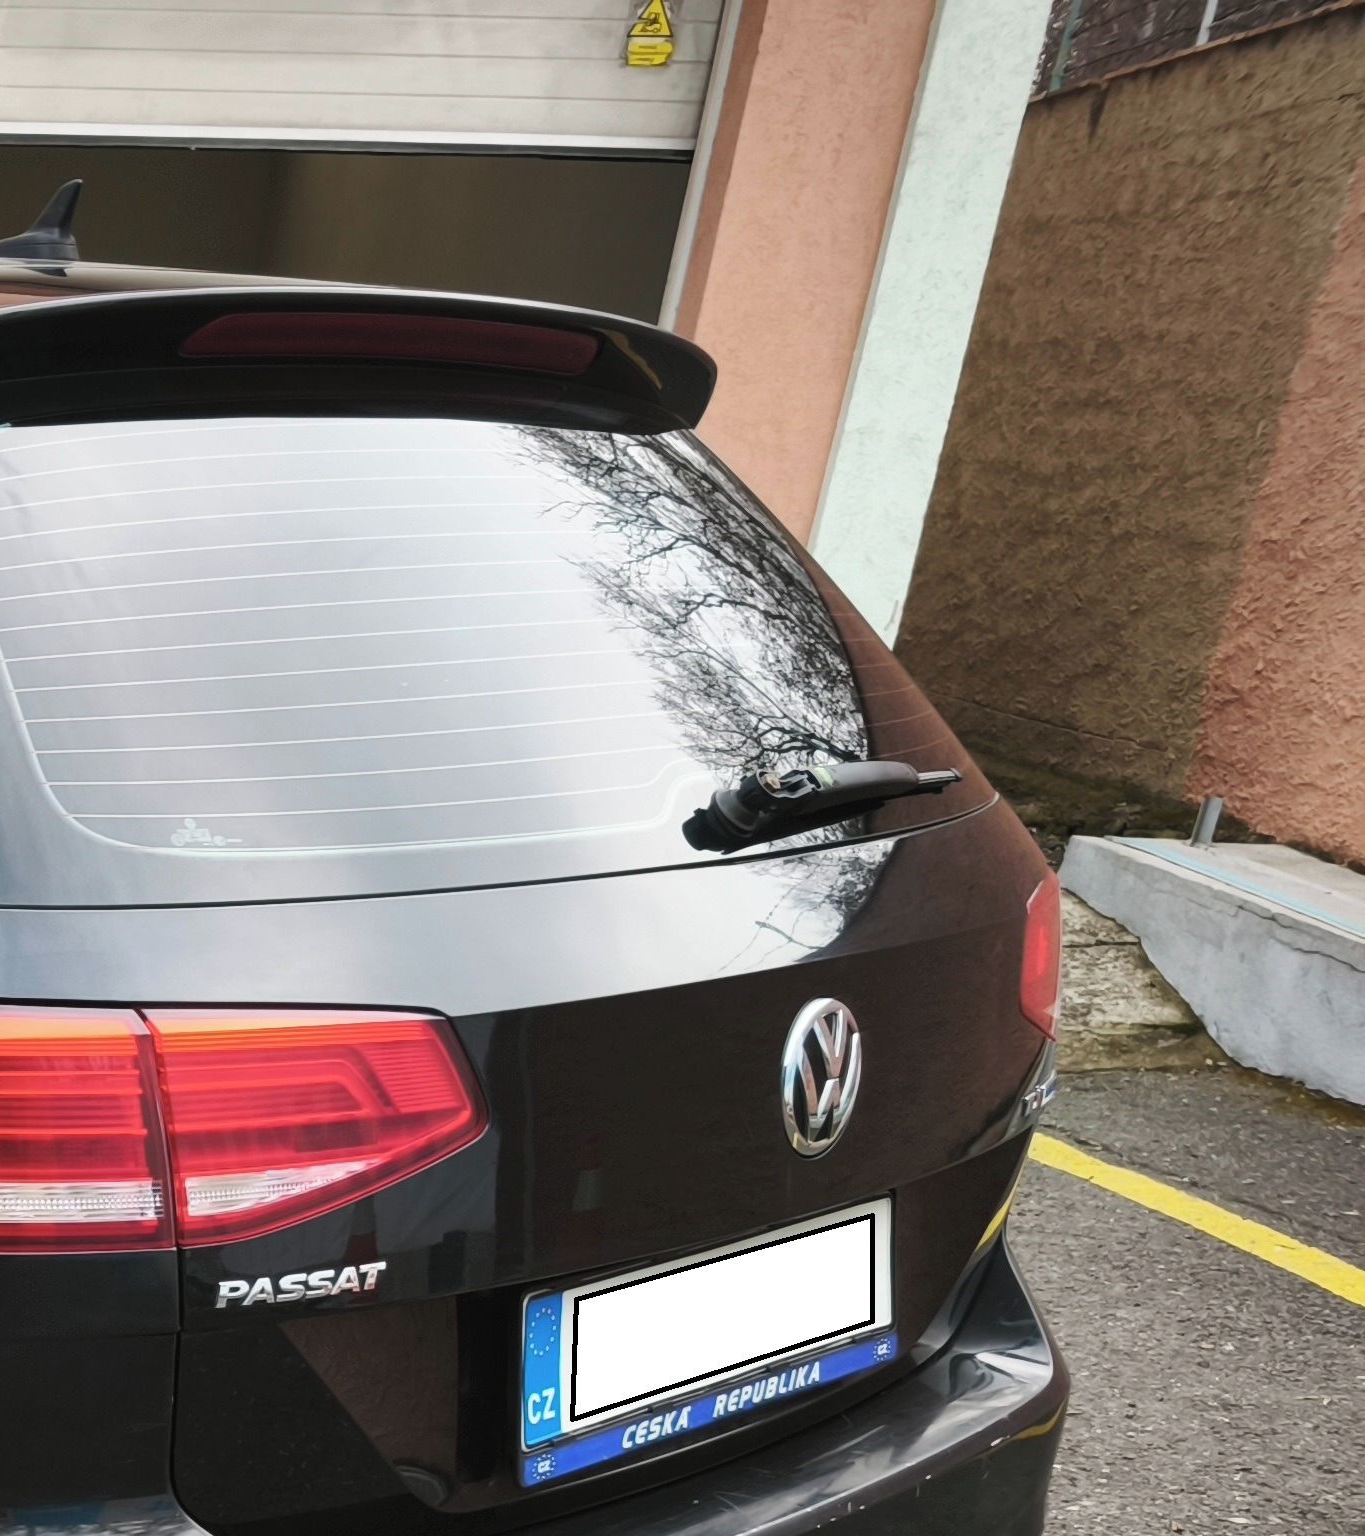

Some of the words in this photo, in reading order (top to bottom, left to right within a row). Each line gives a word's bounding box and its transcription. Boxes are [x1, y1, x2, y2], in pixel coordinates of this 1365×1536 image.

[214, 1261, 387, 1309] PASSAT
[527, 1387, 556, 1425] CZ
[712, 1361, 820, 1418] REPUBLIKA
